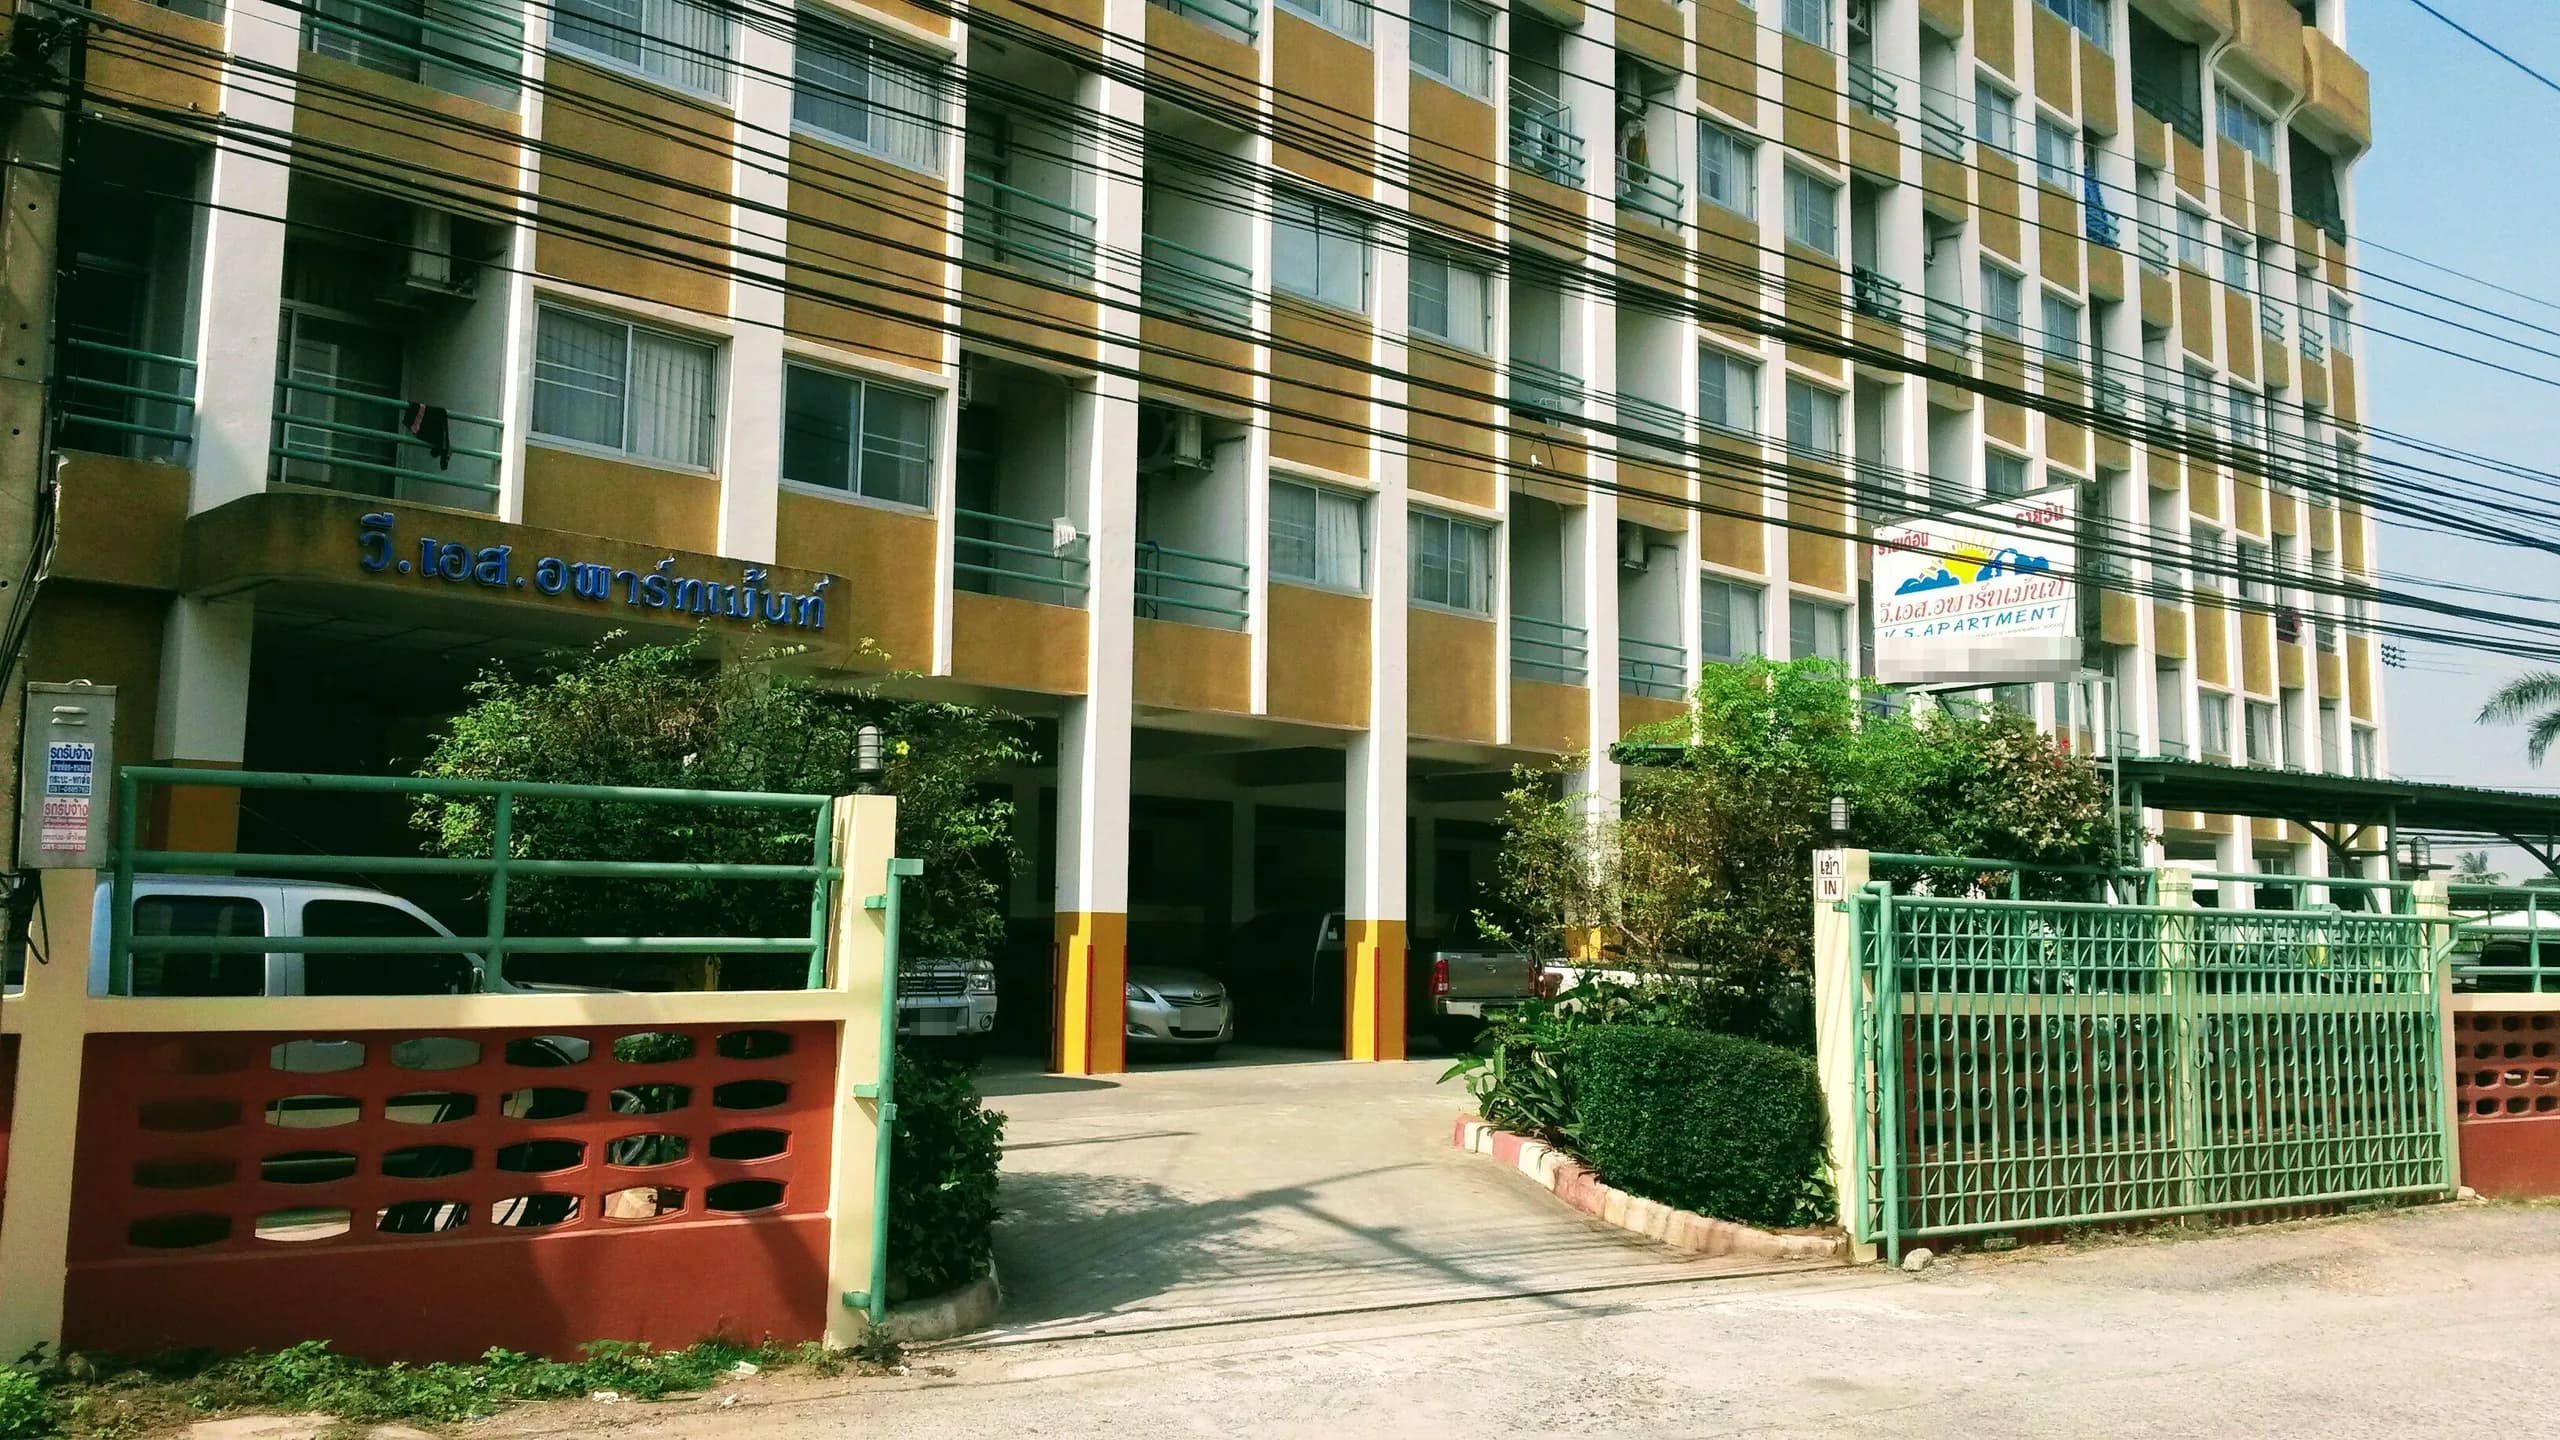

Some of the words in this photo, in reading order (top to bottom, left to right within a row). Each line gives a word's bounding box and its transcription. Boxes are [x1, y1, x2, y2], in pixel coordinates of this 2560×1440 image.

[50, 743, 93, 760] รถรับจ้าง
[44, 798, 89, 817] รถรับจ้าง
[1820, 854, 1840, 875] เข้า
[1824, 880, 1837, 895] IN
